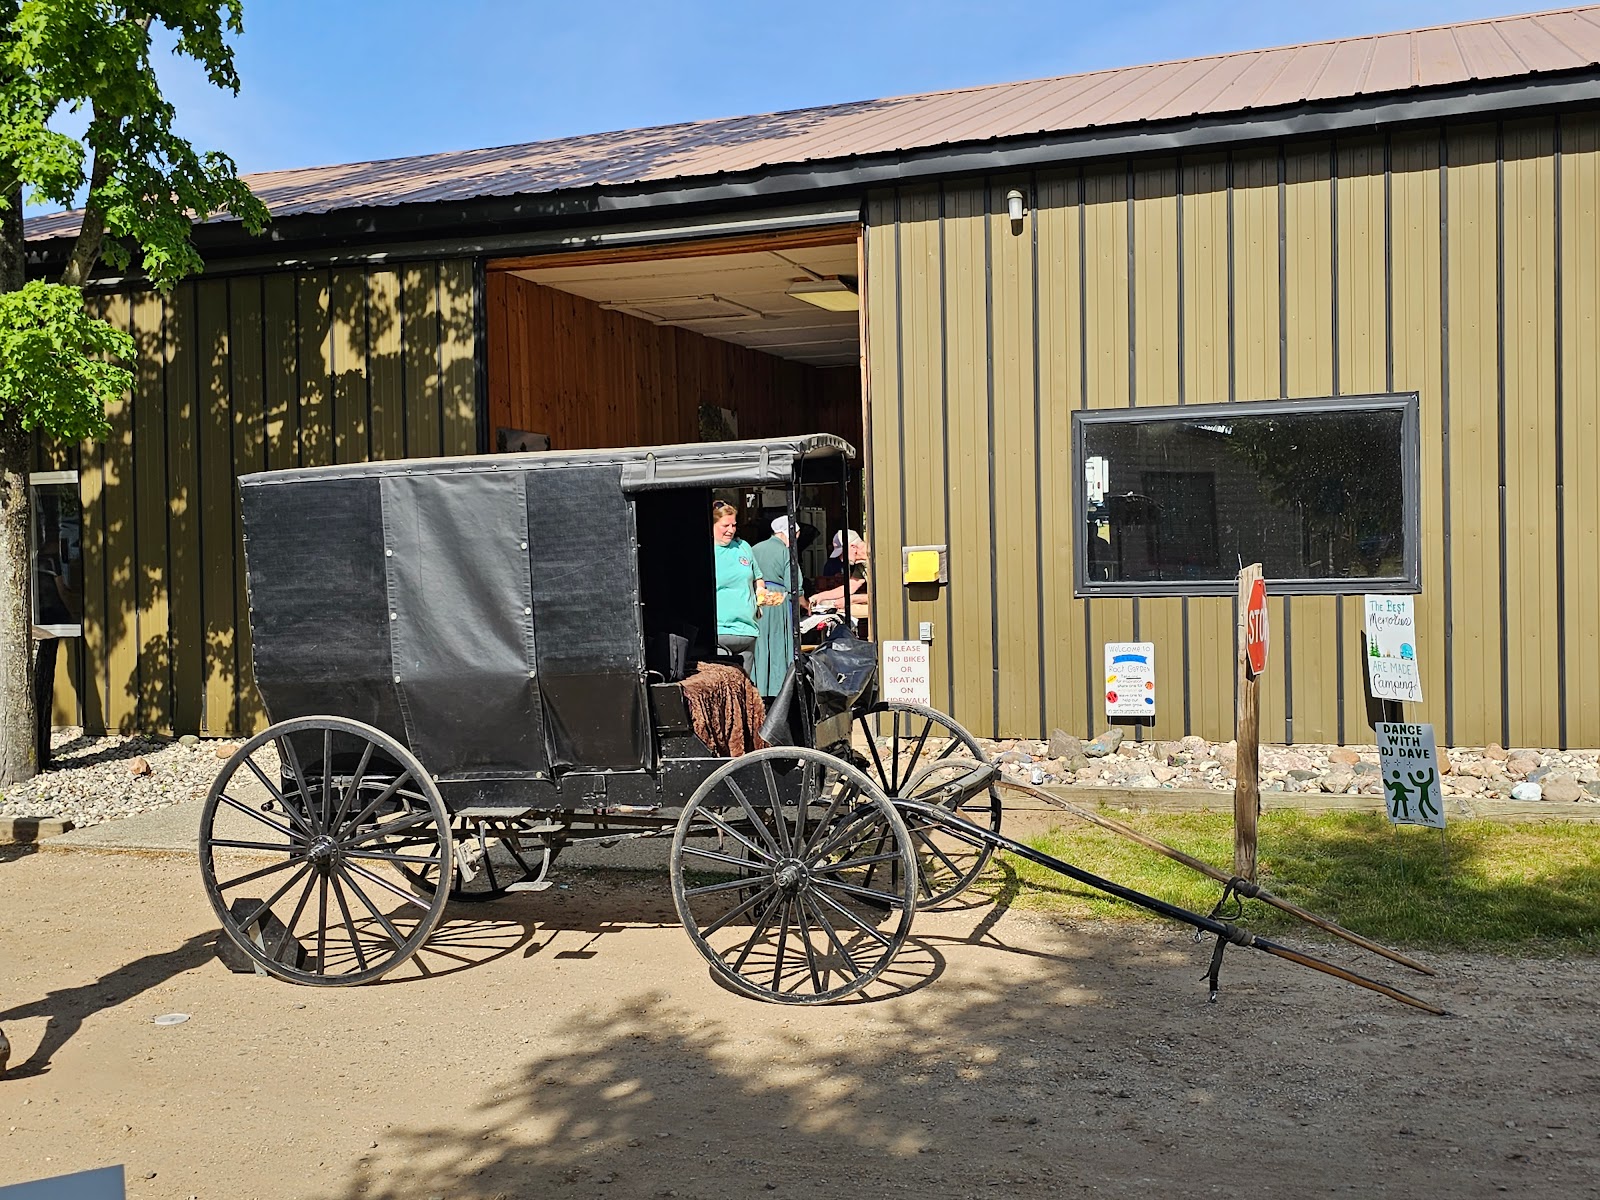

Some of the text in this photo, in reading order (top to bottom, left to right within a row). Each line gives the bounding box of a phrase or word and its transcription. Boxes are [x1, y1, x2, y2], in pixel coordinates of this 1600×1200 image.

[1373, 661, 1411, 675] ARE MADE
[1374, 674, 1417, 698] Camping
[1384, 724, 1422, 735] DANCE
[1388, 736, 1420, 746] WITH
[1382, 746, 1430, 759] DJ DAVE
